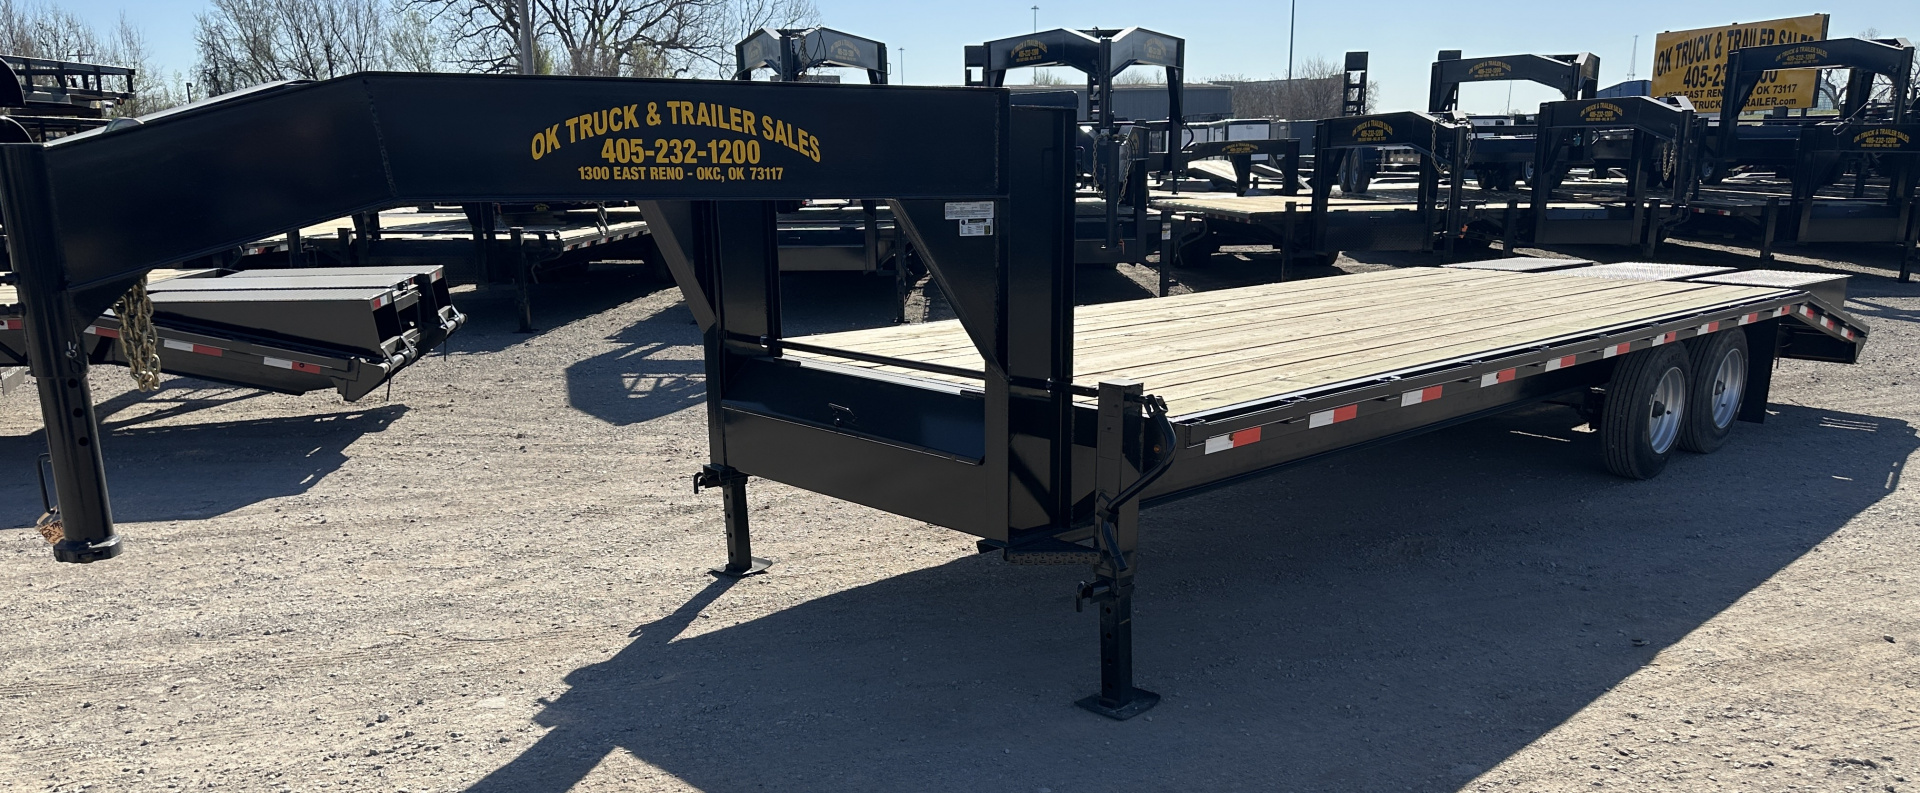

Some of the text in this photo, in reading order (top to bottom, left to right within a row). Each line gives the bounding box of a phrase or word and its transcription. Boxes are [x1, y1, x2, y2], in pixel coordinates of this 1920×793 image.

[1657, 50, 1673, 77] OK
[1676, 33, 1713, 68] TRUCK
[1714, 31, 1723, 59] &
[1683, 64, 1777, 88] 405-200
[1684, 90, 1704, 98] EAST
[1706, 89, 1724, 98] REN
[1756, 86, 1770, 95] OK
[1773, 84, 1797, 94] 73117
[531, 100, 821, 163] OK TRUCK & TRAILER SALES
[601, 138, 761, 164] 405-232-1200
[578, 166, 610, 180] 1300
[613, 166, 646, 180] EAST
[650, 166, 684, 180] RENO
[696, 166, 725, 183] OKC,
[728, 166, 745, 180] OK
[749, 166, 784, 180] 73117
